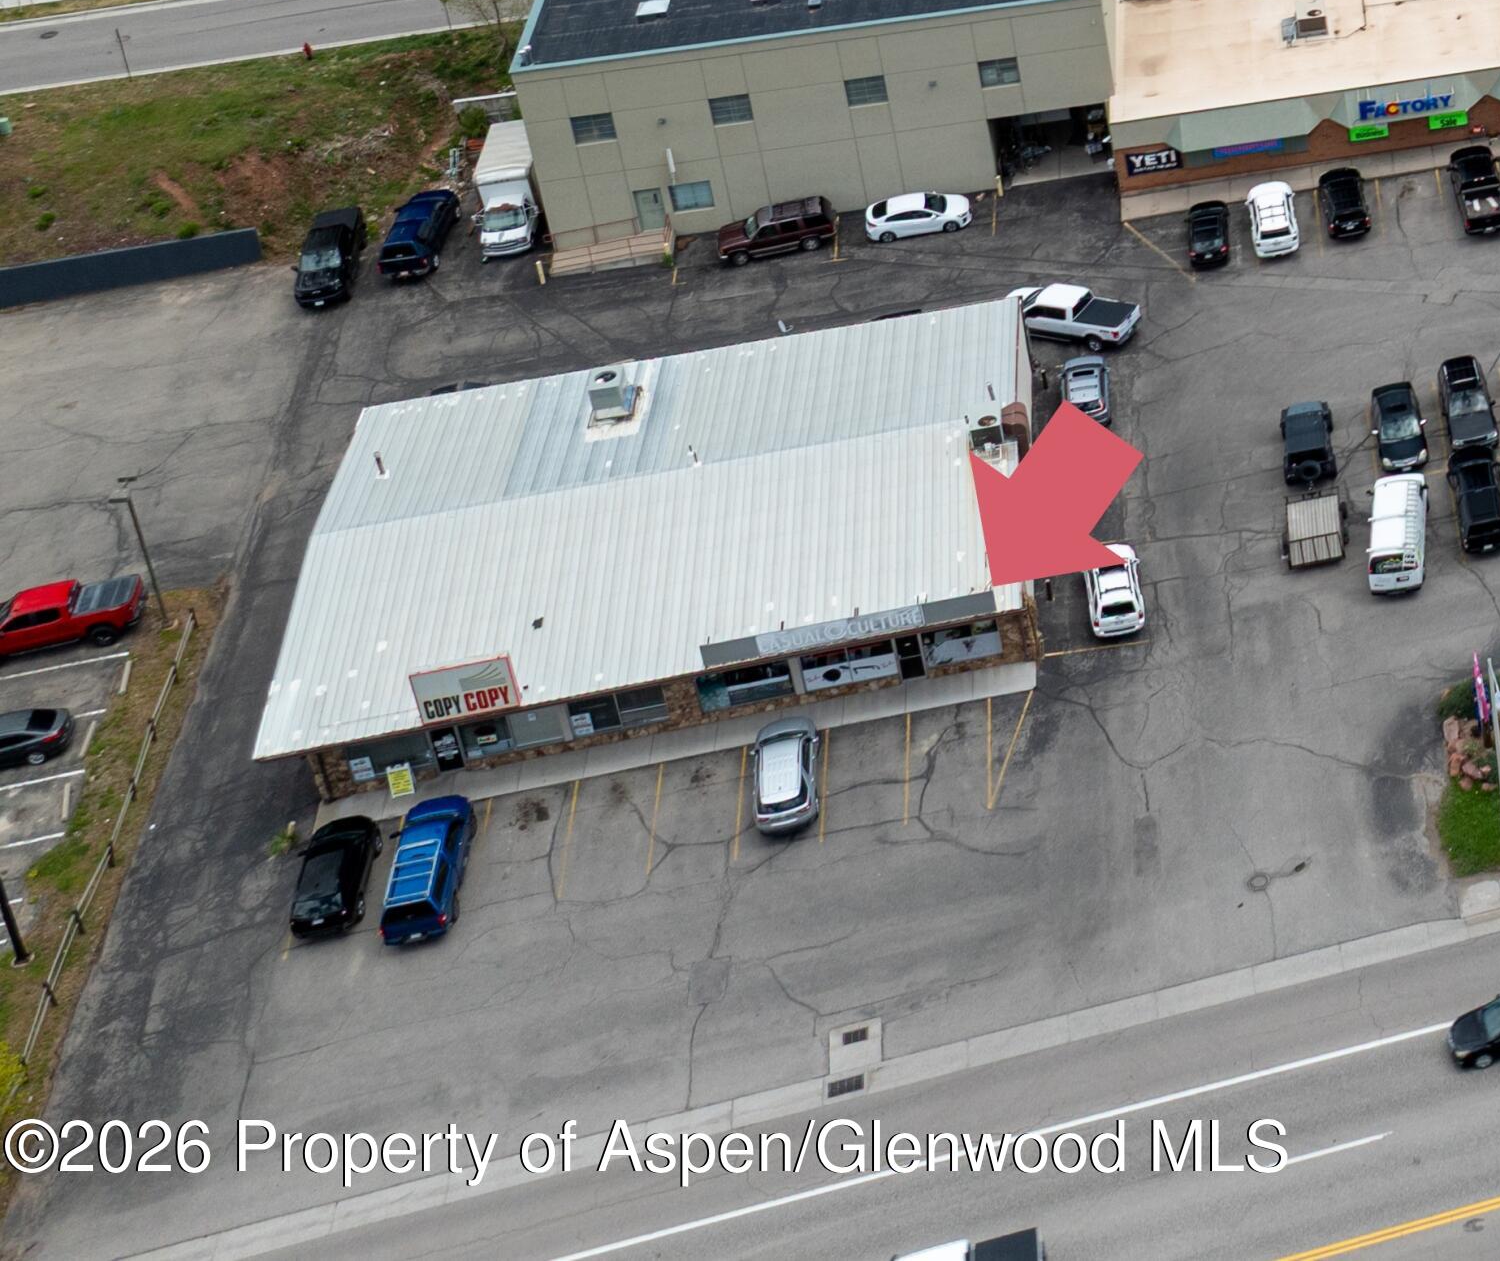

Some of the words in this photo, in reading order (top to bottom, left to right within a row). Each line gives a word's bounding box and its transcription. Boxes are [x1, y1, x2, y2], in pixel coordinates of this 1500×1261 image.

[1359, 95, 1452, 120] FACTORY
[1129, 149, 1176, 168] YETI
[846, 609, 923, 636] CULTURE
[423, 694, 462, 720] COPY
[464, 685, 510, 712] COPY
